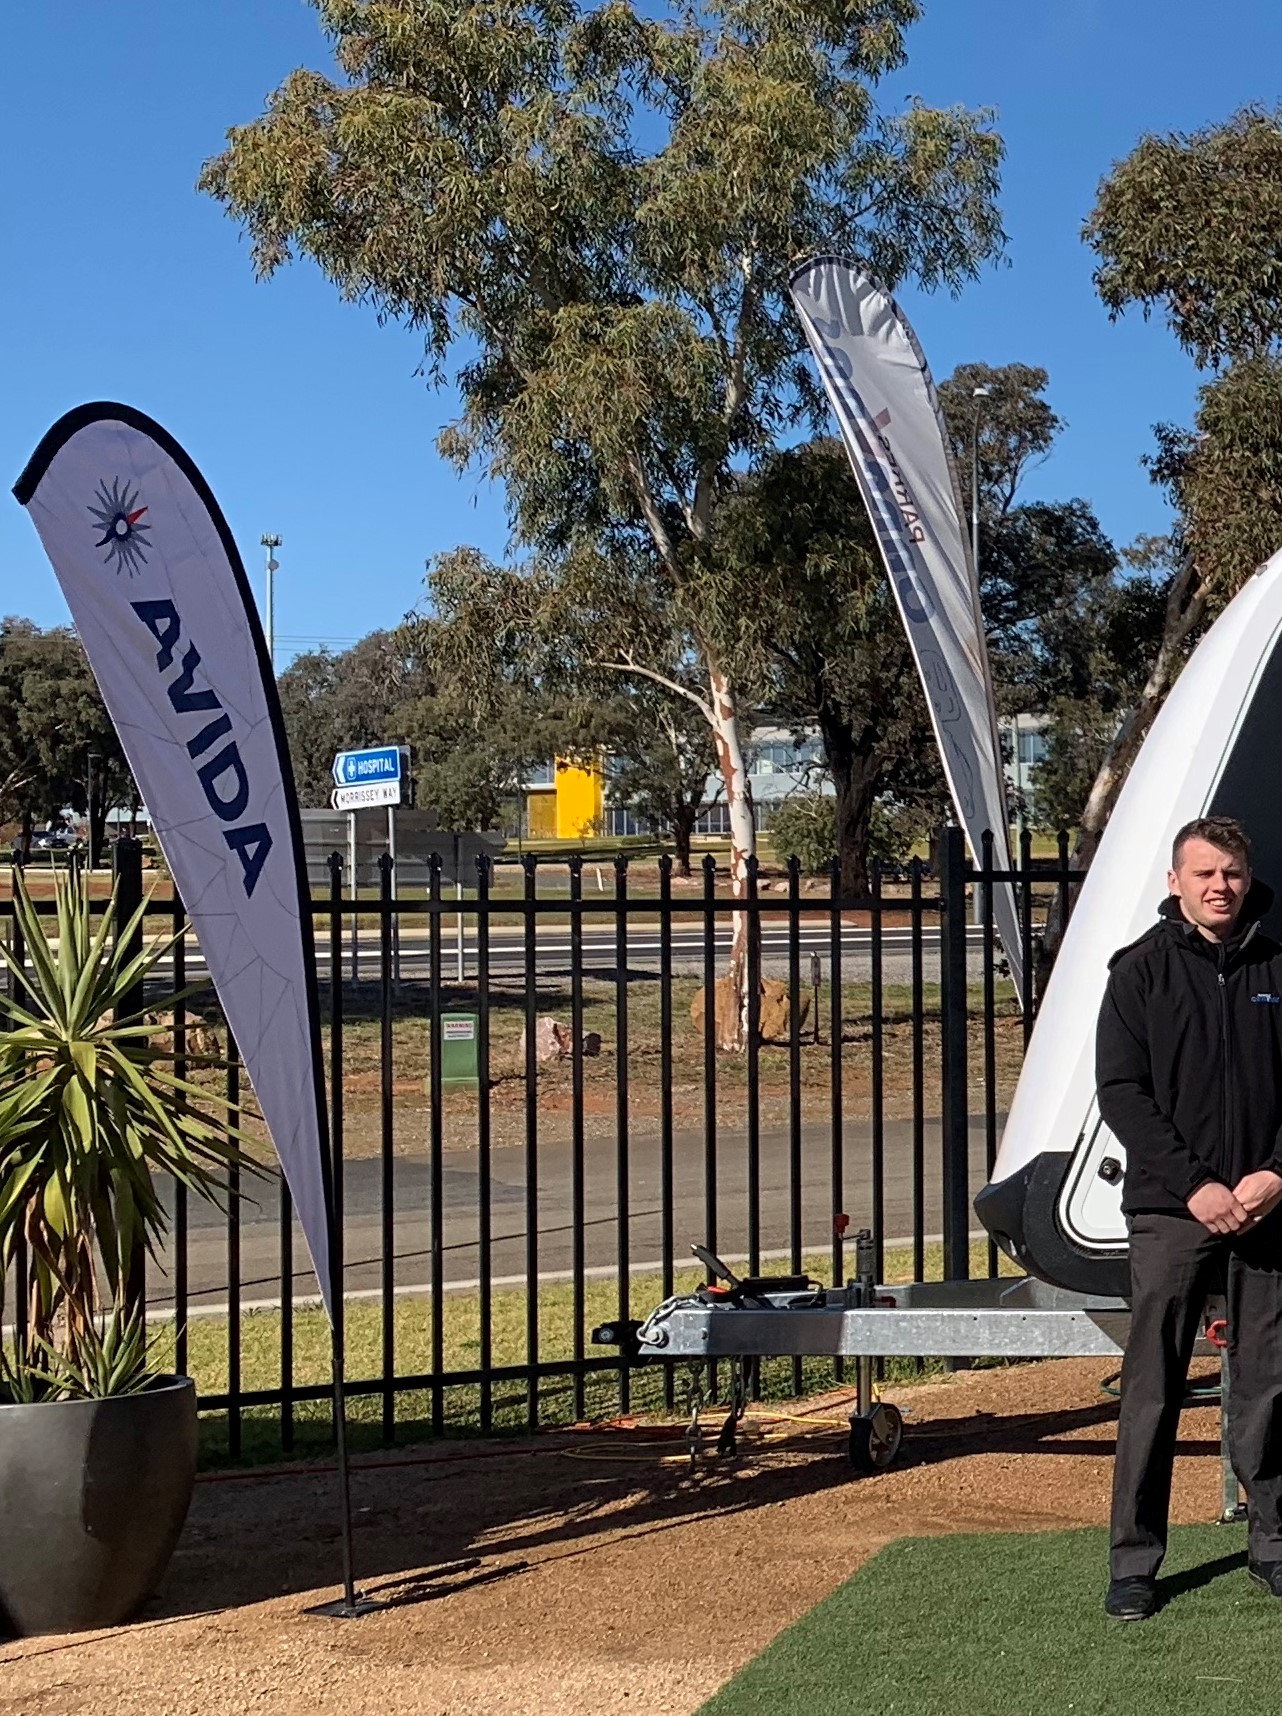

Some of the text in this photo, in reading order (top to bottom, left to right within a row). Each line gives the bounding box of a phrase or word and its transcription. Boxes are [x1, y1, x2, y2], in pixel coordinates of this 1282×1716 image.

[129, 598, 273, 900] AVIDA
[357, 757, 395, 775] HOSPITAL
[340, 786, 397, 804] MORRISSEY WAY
